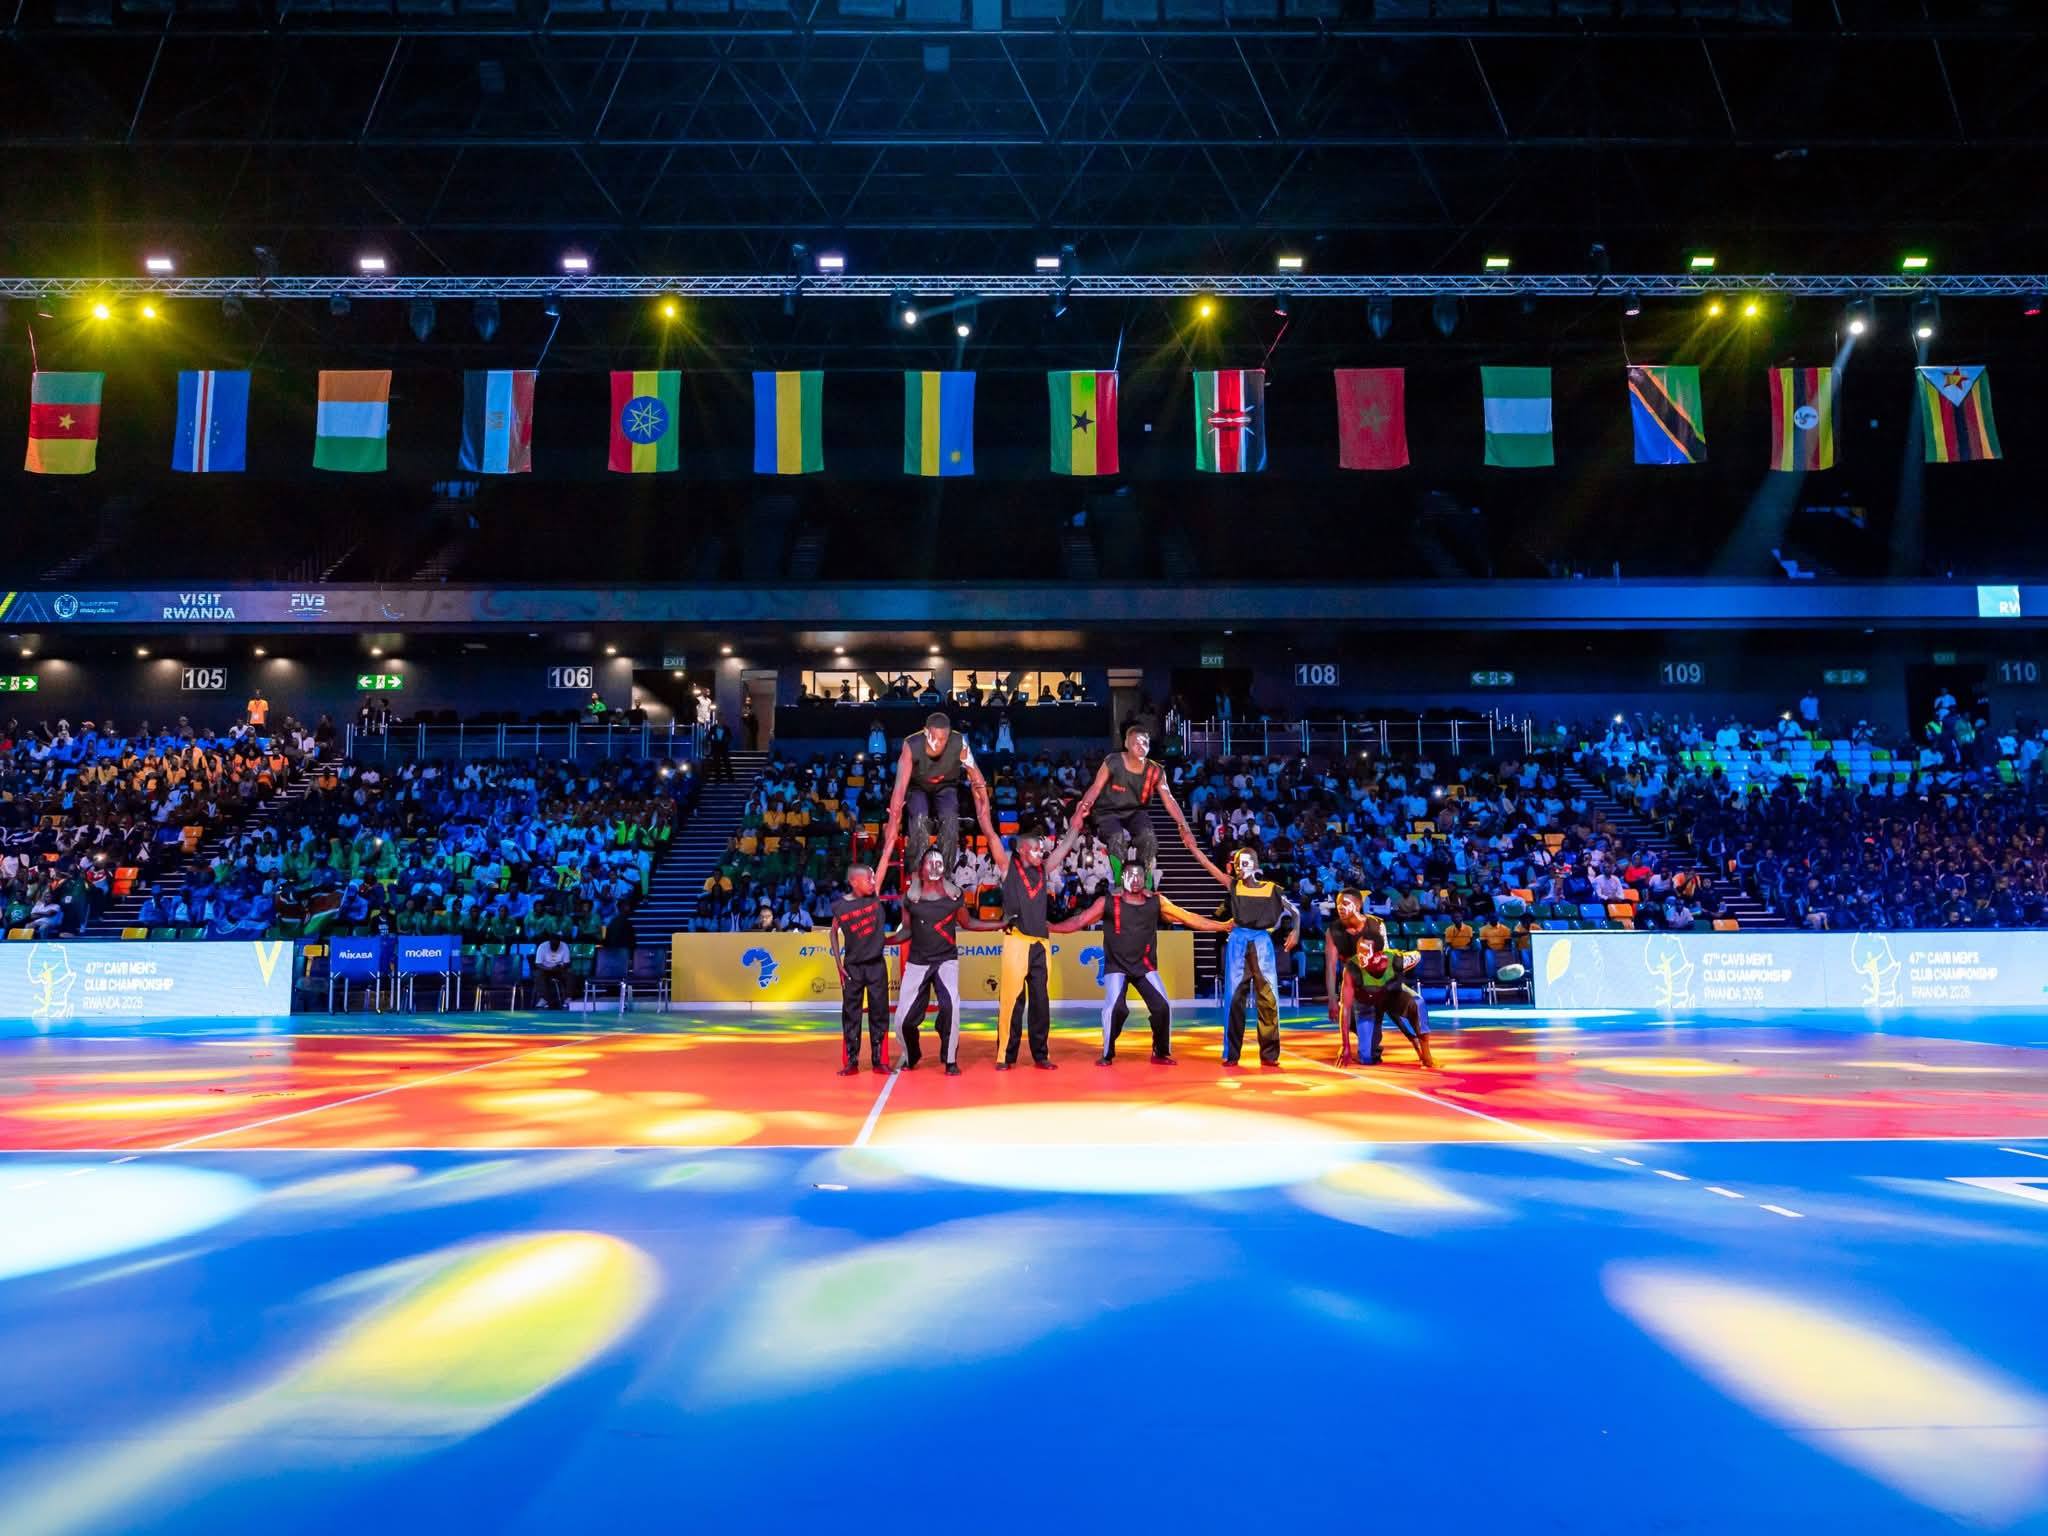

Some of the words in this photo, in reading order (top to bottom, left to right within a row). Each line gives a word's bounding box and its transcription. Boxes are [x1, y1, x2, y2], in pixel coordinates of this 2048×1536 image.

[179, 593, 222, 606] VISIT
[291, 593, 325, 606] FIVB
[163, 607, 236, 620] RWANDA
[663, 657, 685, 666] EXIT
[1201, 656, 1224, 665] EXIT
[185, 669, 224, 689] 105
[551, 668, 589, 687] 106
[1298, 665, 1336, 684] 108
[1664, 663, 1701, 683] 109
[2001, 663, 2037, 682] 110
[405, 948, 441, 957] molten
[1703, 969, 1726, 982] CLUB
[1726, 969, 1792, 983] CHAMPIONSHIP
[1911, 967, 1933, 981] CLUB
[1934, 967, 1998, 981] CHAMPIONSHIP
[84, 978, 107, 991] CLUB
[108, 978, 174, 991] CHAMPIONSHIP
[1704, 987, 1742, 1000] RWANDA
[1912, 985, 1948, 999] RWANDA
[83, 996, 120, 1009] RWANDA
